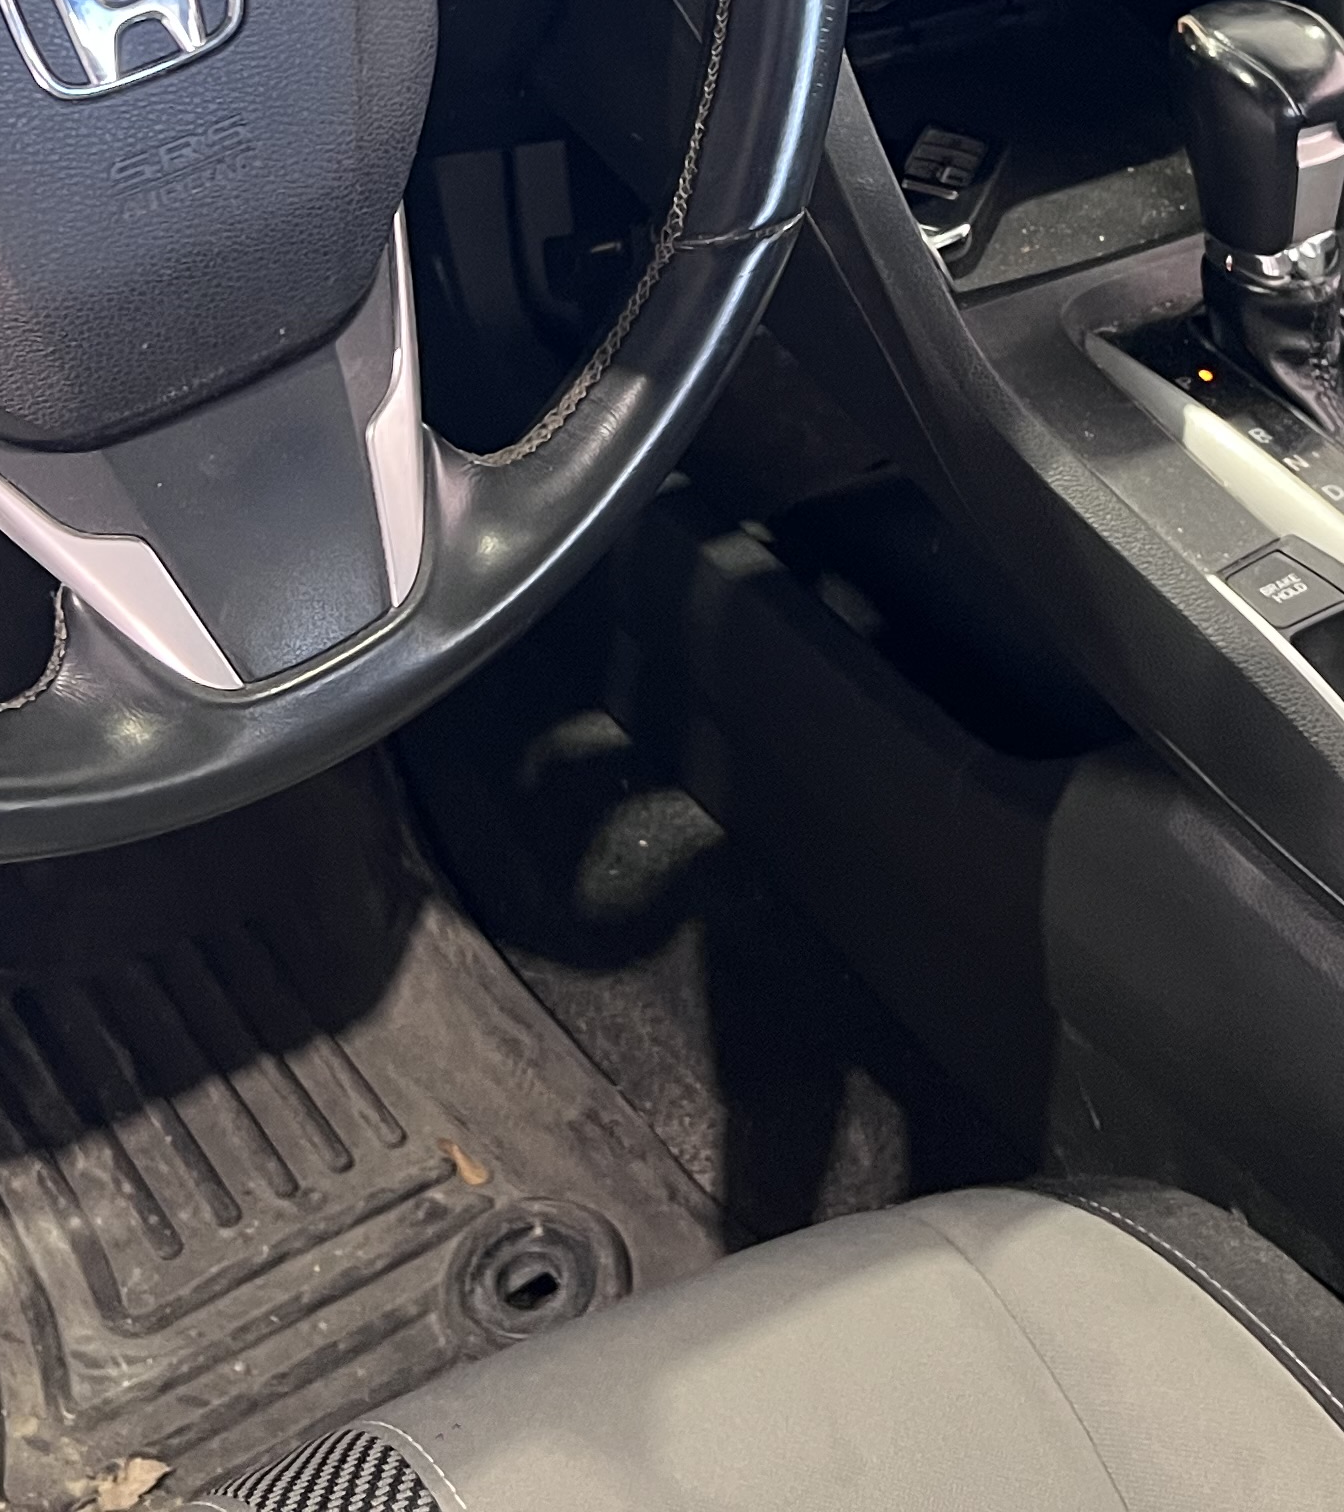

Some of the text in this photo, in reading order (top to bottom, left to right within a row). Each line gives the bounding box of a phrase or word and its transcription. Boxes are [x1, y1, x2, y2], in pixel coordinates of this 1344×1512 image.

[1281, 453, 1311, 473] N
[1259, 572, 1302, 598] BRAKE
[1271, 582, 1308, 604] HOLD
